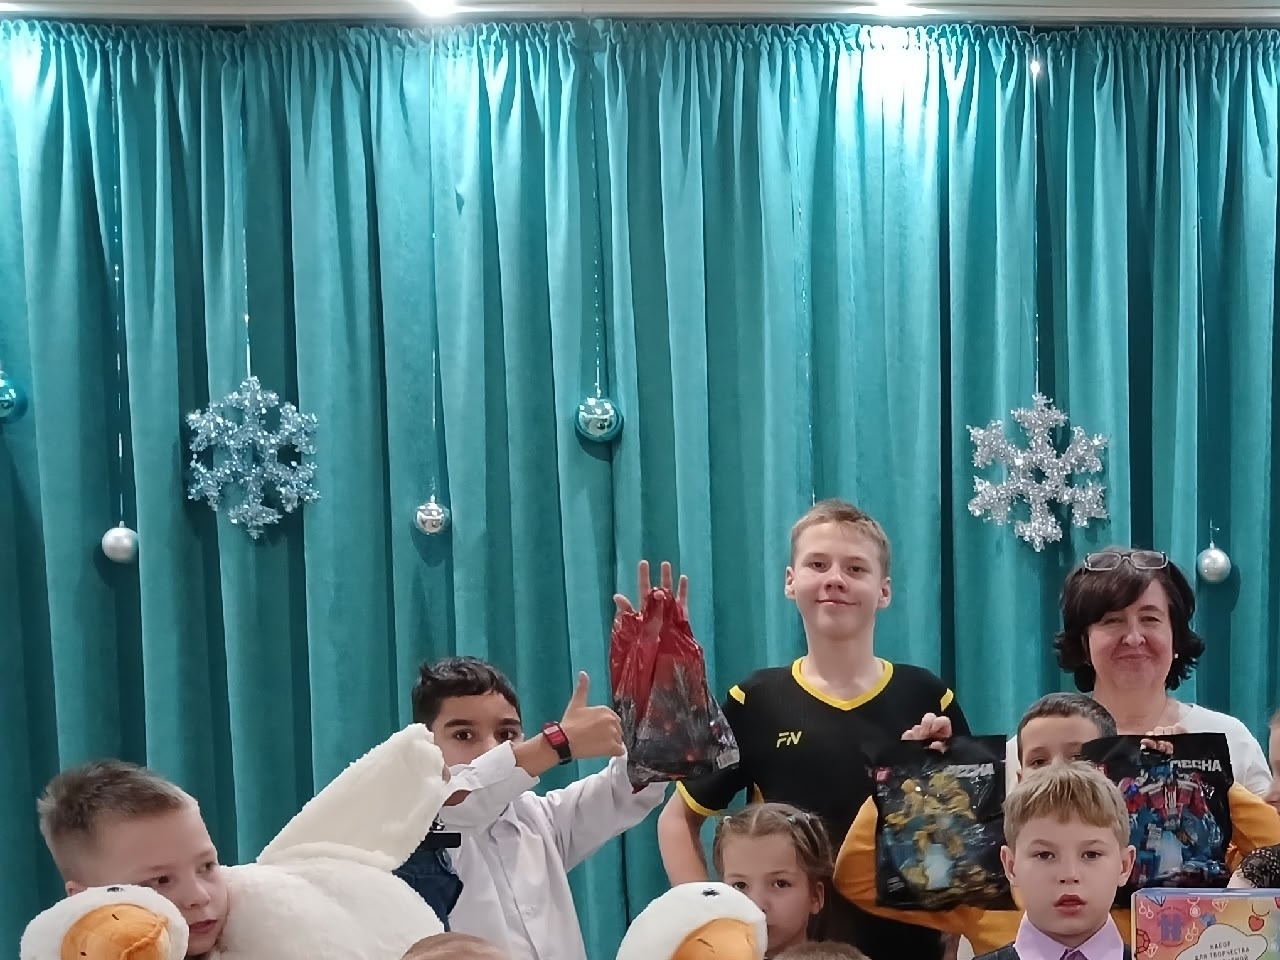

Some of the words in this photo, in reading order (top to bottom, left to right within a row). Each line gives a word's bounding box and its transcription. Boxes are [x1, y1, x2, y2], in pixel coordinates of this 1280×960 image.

[776, 731, 802, 748] FN
[1209, 941, 1231, 950] НАБОР
[1209, 947, 1250, 958] ТВОРЧЕСТВА
